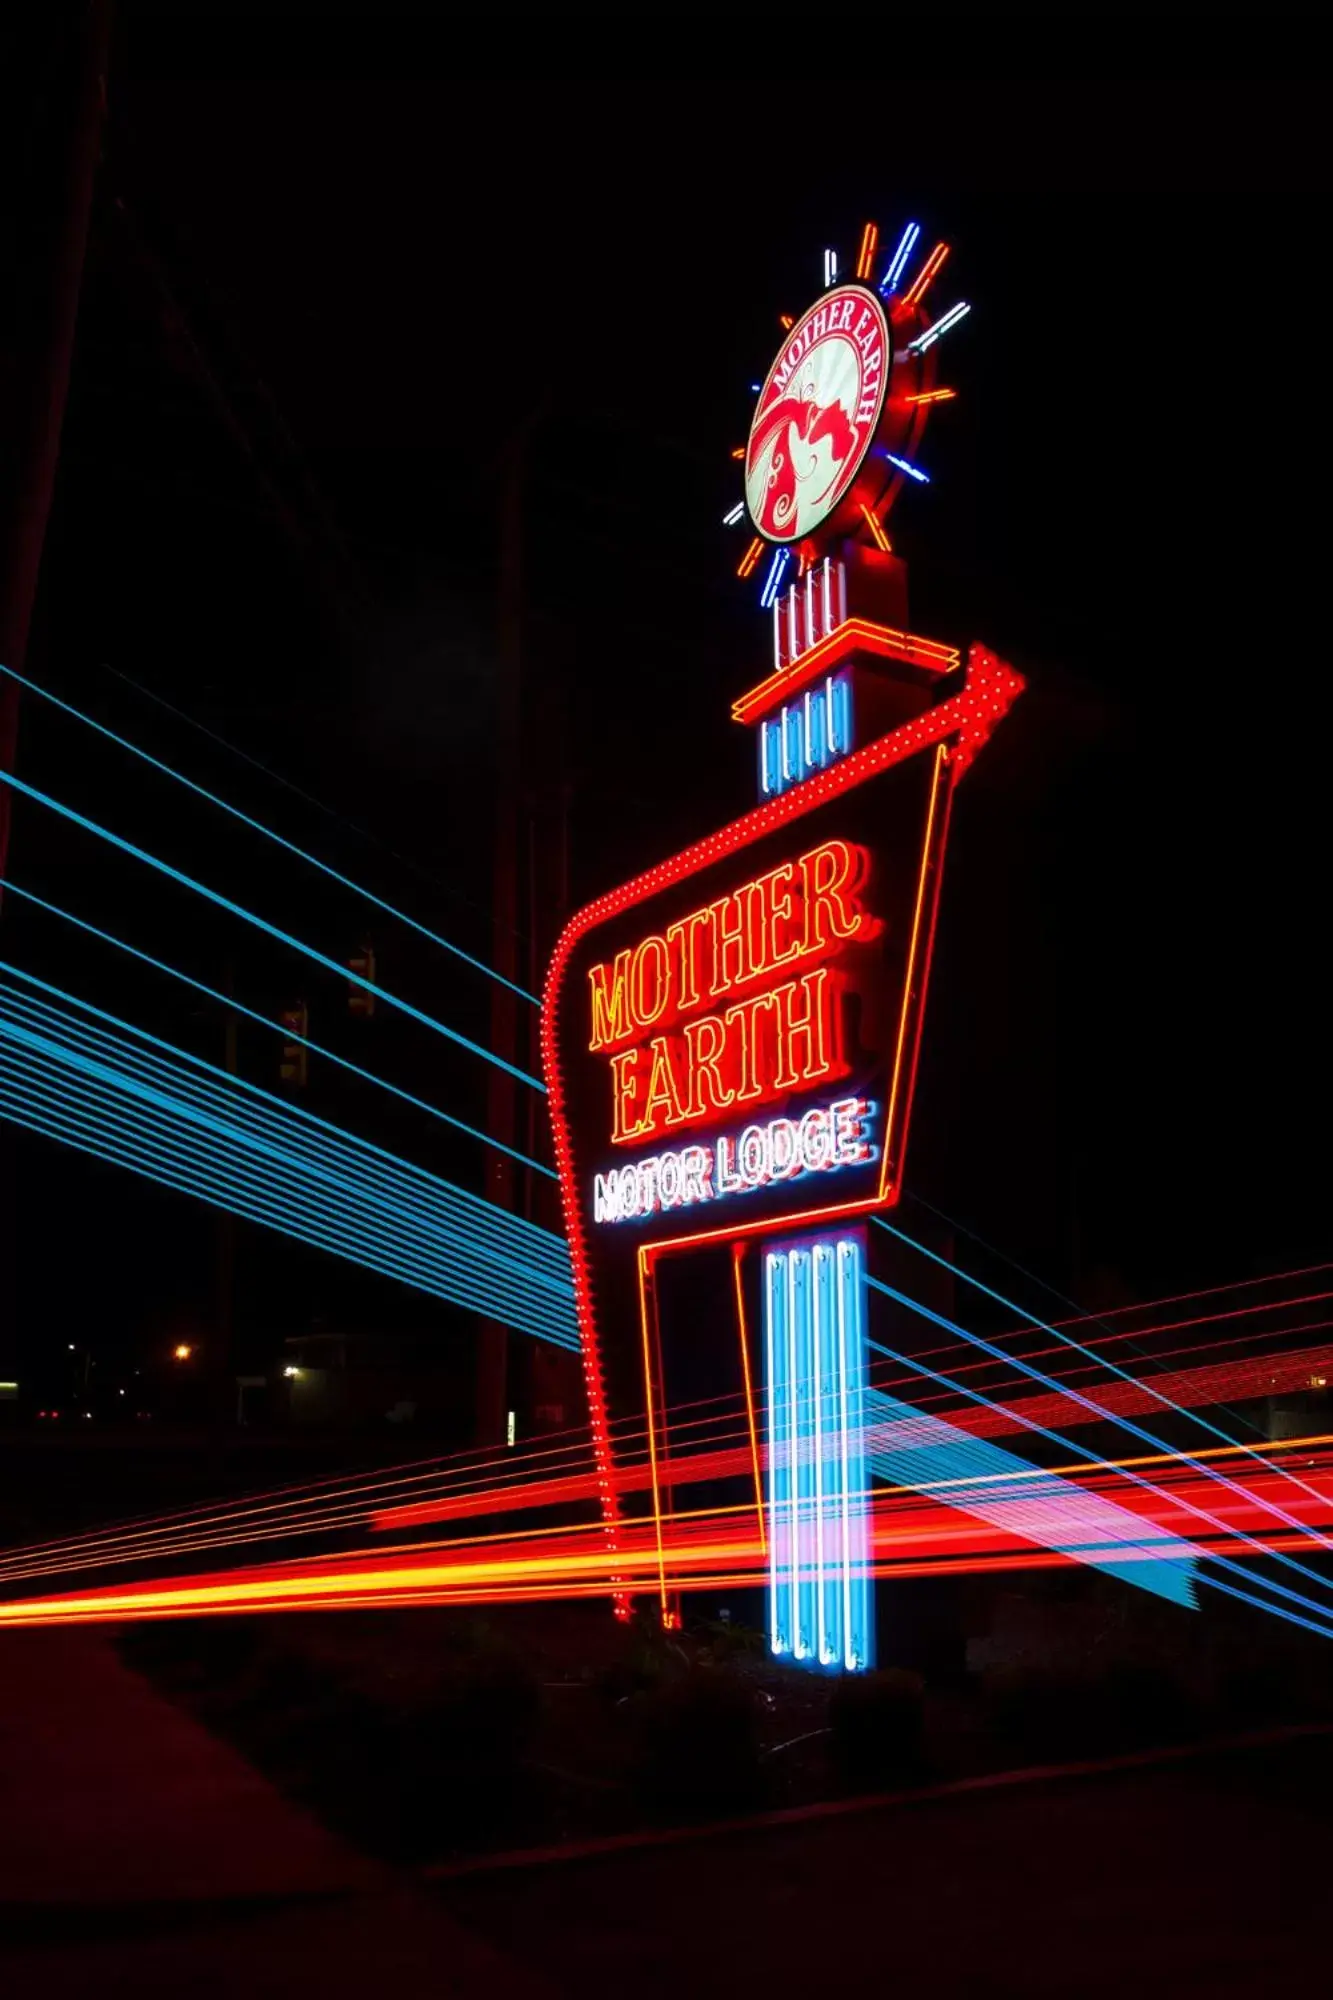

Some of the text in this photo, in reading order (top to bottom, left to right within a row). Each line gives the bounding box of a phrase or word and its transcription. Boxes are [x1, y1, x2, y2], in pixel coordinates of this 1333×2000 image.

[773, 299, 881, 424] MOTHER EARTH
[588, 840, 863, 1052] MOTHER
[610, 968, 831, 1144] EARTH
[594, 1098, 864, 1223] MOTOR LODGE
